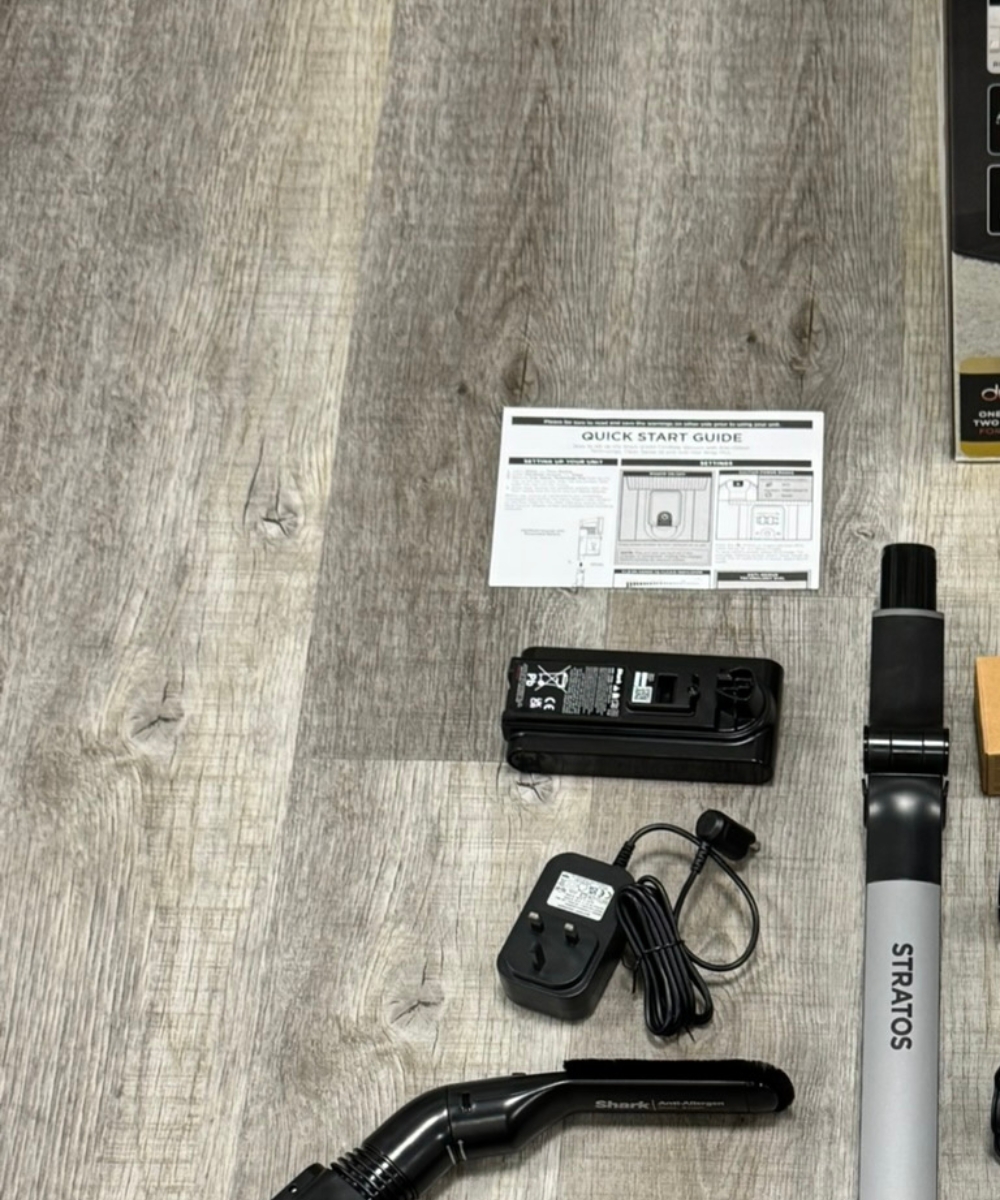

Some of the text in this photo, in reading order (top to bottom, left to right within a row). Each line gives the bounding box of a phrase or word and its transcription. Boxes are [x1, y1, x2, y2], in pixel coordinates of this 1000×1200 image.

[973, 419, 1000, 427] TWO
[581, 431, 743, 443] QUICK START GUIDE
[890, 943, 913, 1050] STRATOS
[594, 1099, 650, 1109] Shark
